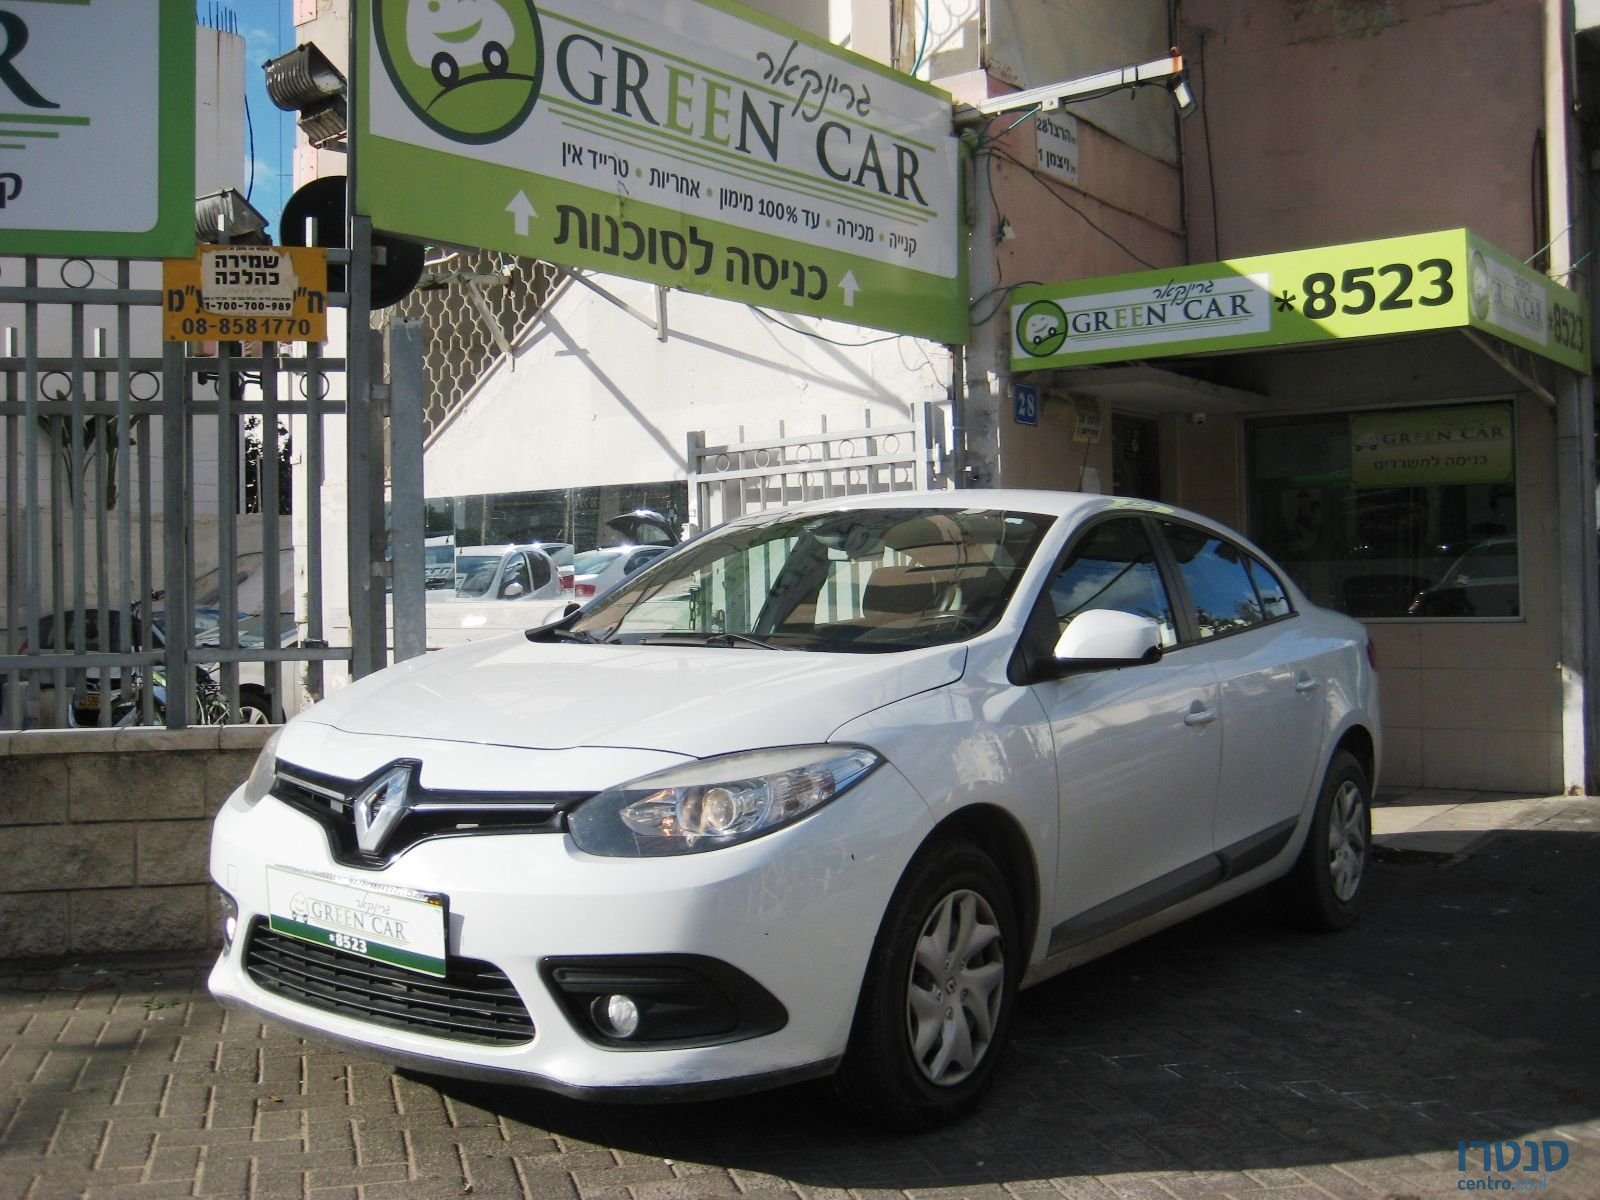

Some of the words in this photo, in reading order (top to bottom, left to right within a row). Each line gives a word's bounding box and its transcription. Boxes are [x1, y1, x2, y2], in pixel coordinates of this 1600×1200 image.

[556, 33, 785, 163] GREEN
[816, 121, 929, 206] CAR
[562, 141, 583, 168] אין
[588, 148, 629, 178] טרייד
[649, 167, 701, 199] אחריות
[719, 187, 754, 212] מימון
[758, 198, 798, 224] 100%
[801, 209, 820, 230] עד
[837, 218, 874, 243] מכירה
[553, 204, 714, 276] לסוכנות
[889, 232, 917, 258] קנייה
[215, 254, 280, 269] שמירה
[726, 246, 828, 301] כניסה
[215, 269, 280, 285] כהלכה
[204, 301, 292, 311] 1-700-700-989
[1071, 303, 1167, 334] GREEN
[1183, 294, 1252, 321] CAR
[182, 317, 311, 336] 08-8581770
[1018, 391, 1035, 417] 28
[1382, 428, 1452, 446] GREEN
[1460, 425, 1505, 441] CAR
[1445, 455, 1489, 468] כניסה
[311, 900, 365, 930] GREEN
[371, 916, 407, 941] CAR
